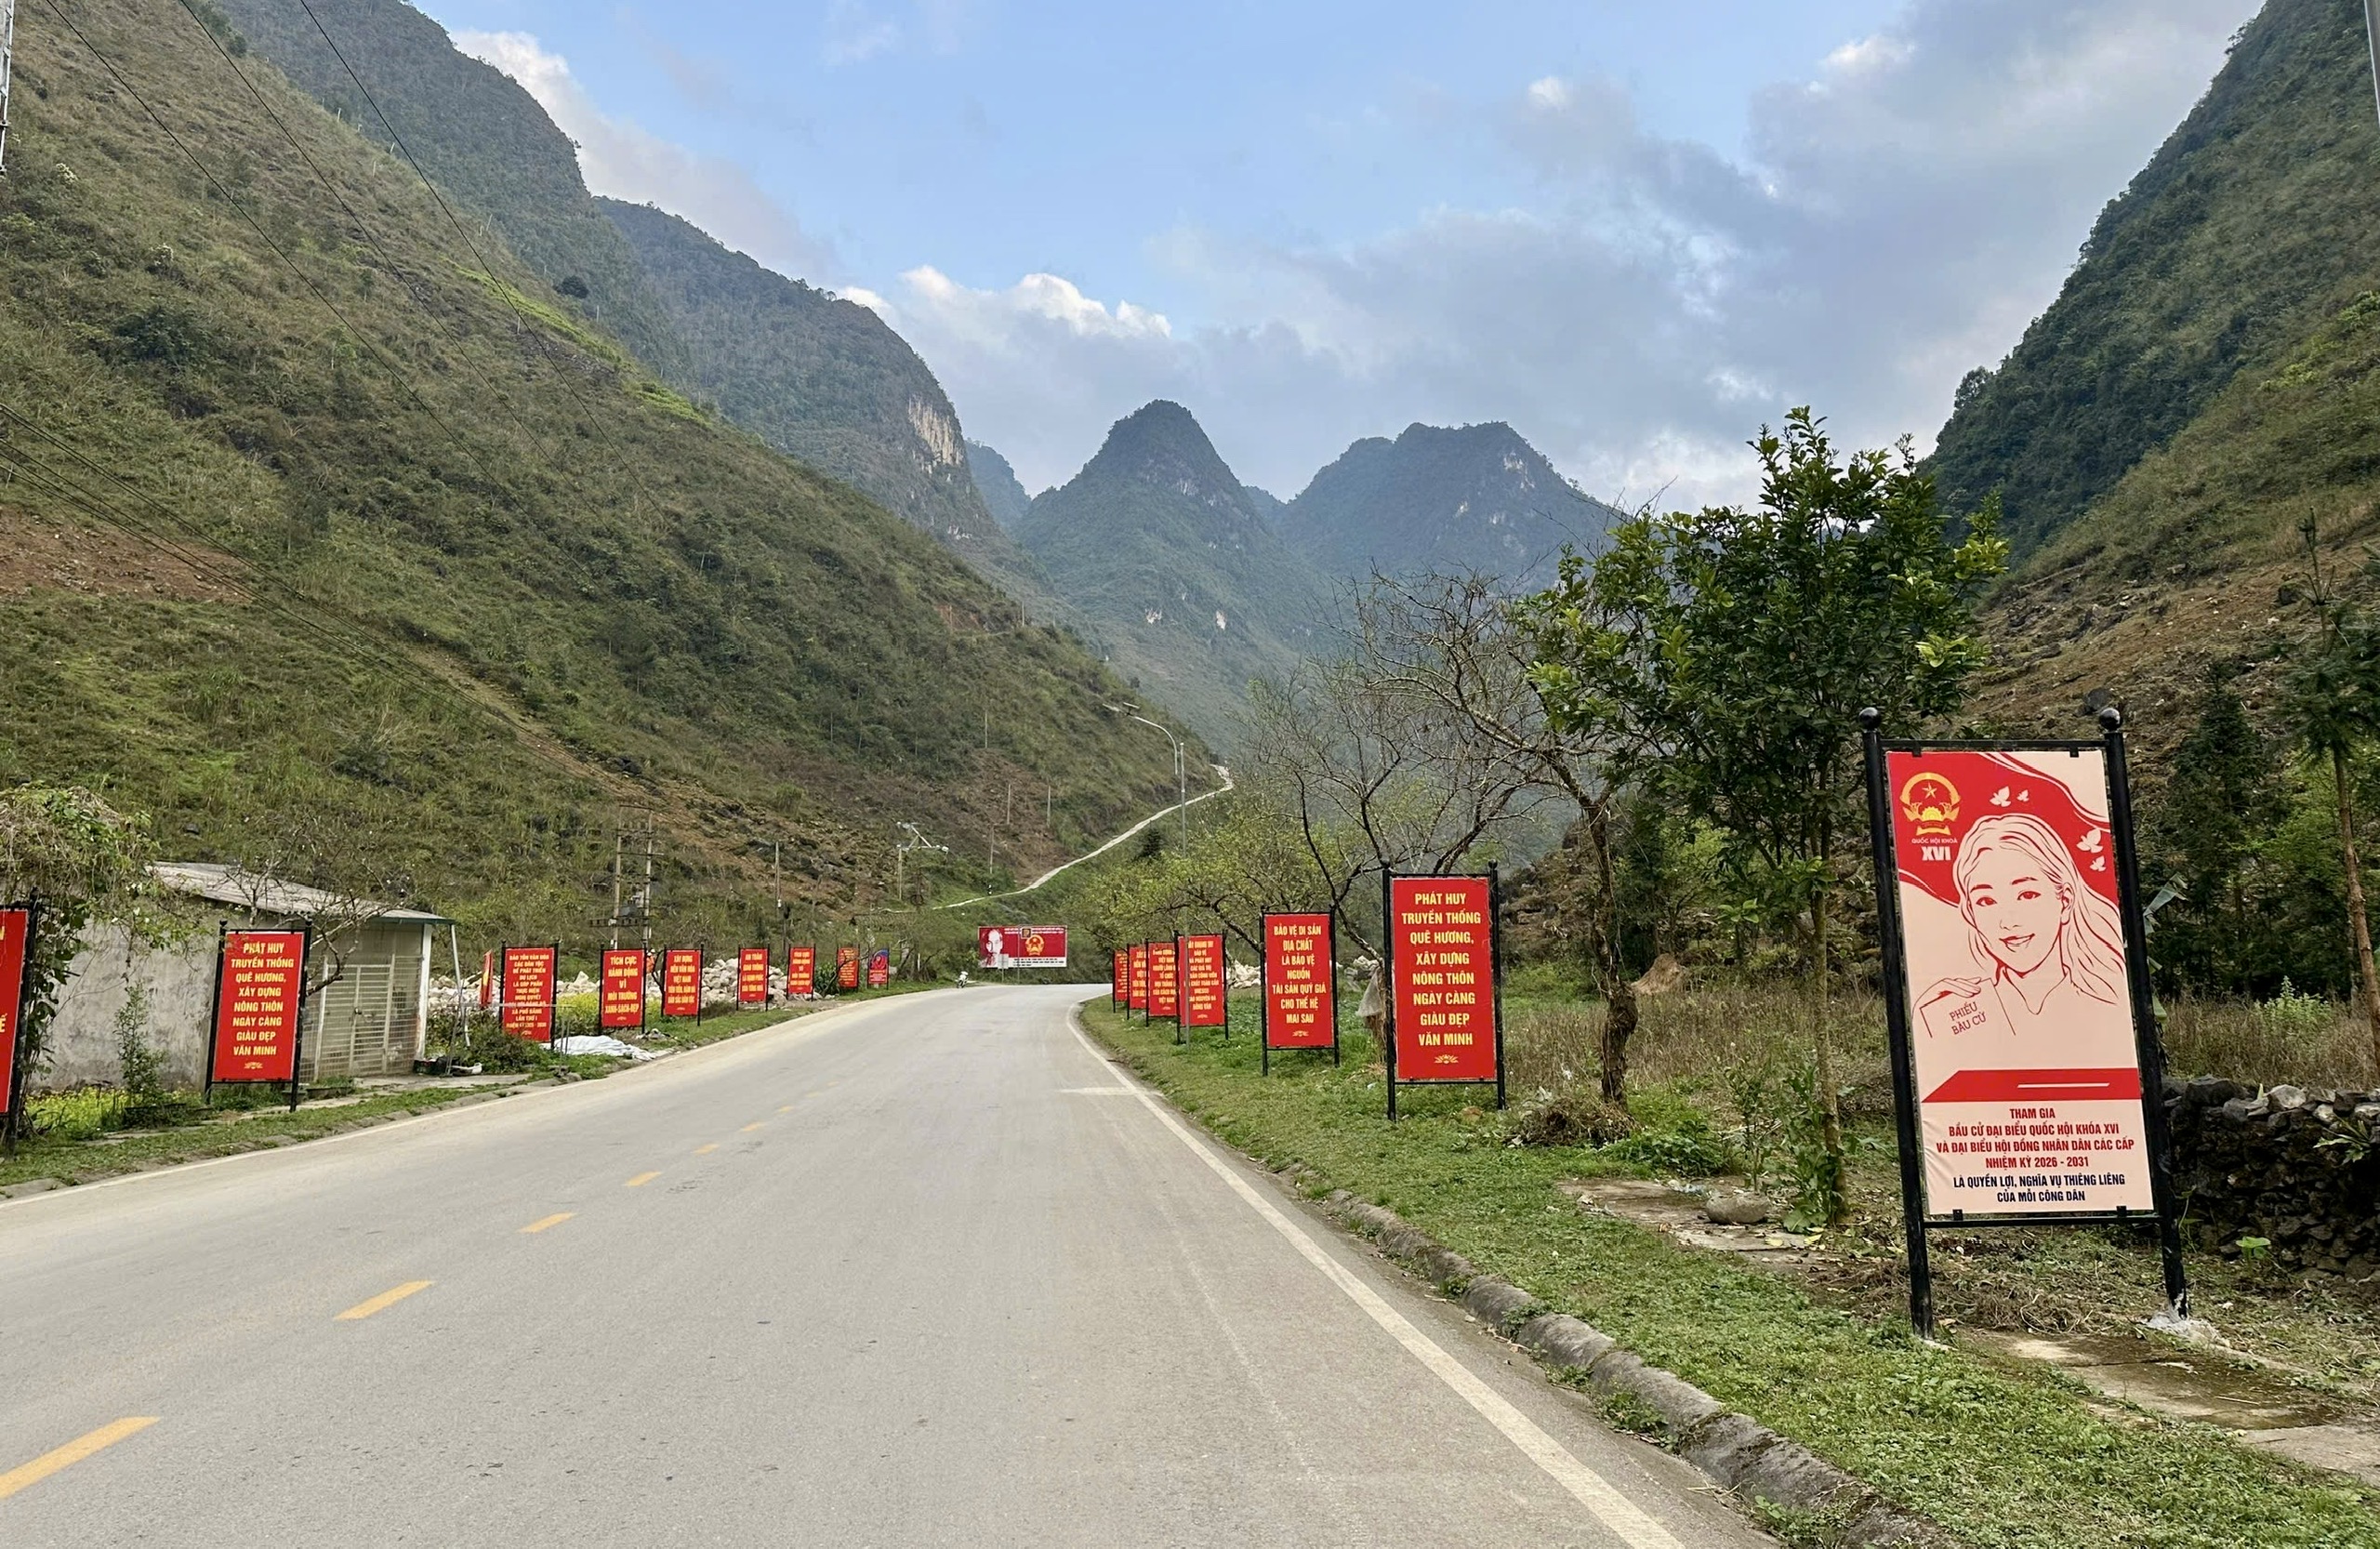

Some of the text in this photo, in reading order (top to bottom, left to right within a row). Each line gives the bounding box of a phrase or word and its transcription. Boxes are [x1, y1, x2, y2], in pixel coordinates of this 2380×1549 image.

[1921, 846, 1951, 861] XVI
[1415, 890, 1466, 905] PHÁT HUY
[1402, 908, 1481, 924] TRUYỀN THỐNG
[1274, 923, 1321, 937] BẢO VỆ DI SẢN
[1283, 936, 1313, 953] ĐỊA CHẤT
[1410, 930, 1474, 946] QUÊ HƯƠNG,
[243, 941, 285, 954] PHÁT HUY
[266, 956, 294, 968] THỐNG
[1282, 952, 1315, 967] LÀ BẢO VỆ
[1416, 951, 1469, 967] XÂY DỰNG
[236, 971, 286, 984] QUÊ HƯƠNG,
[619, 978, 626, 989] VÌ
[1413, 970, 1474, 985] NÔNG THÔN
[238, 986, 281, 999] XÂY DỰNG
[1272, 982, 1283, 994] TÀI
[1300, 982, 1313, 995] QUÝ
[1315, 982, 1326, 993] GIÁ
[1281, 995, 1319, 1011] CHO THẾ HỆ
[1413, 990, 1475, 1005] NGÀY CÀNG
[234, 1001, 283, 1012] NÔNG THÔN
[1949, 1001, 1977, 1021] PHIẾU
[233, 1015, 282, 1027] NGÀY CÀNG
[1286, 1014, 1314, 1024] MAI SAU
[1420, 1010, 1469, 1028] GIÀU ĐẸP
[236, 1029, 276, 1043] GIÀU ĐẸP
[1418, 1031, 1473, 1046] VĂN MINH
[233, 1044, 277, 1056] VĂN MINH
[2010, 1108, 2055, 1119] THAM GIA
[1949, 1119, 2119, 1138] BẦU CỬ ĐẠI BIỂU QUỐC HỘI KHÓA XVI
[1937, 1140, 1949, 1153] VÀ
[1951, 1142, 1968, 1154] ĐẠI
[1970, 1138, 1992, 1153] BIỂU
[1995, 1140, 2010, 1154] HỘI
[2042, 1140, 2069, 1152] NHÂN
[2072, 1139, 2091, 1151] DÂN
[2094, 1139, 2113, 1151] CÁC
[2116, 1136, 2134, 1150] CẤP
[1985, 1156, 2017, 1170] NHIỆM
[2019, 1156, 2031, 1168] KỲ
[2034, 1157, 2057, 1168] 2026
[2067, 1156, 2089, 1167] 2031
[1954, 1174, 1965, 1188] LÀ
[2000, 1175, 2017, 1189] LỢI,
[2019, 1173, 2047, 1187] NGHĨA
[2049, 1175, 2062, 1188] VỤ
[2063, 1173, 2096, 1186] THIÊNG
[2098, 1172, 2125, 1185] LIÊNG
[1997, 1189, 2085, 1202] CỦA MỖI CÔNG DÂN
